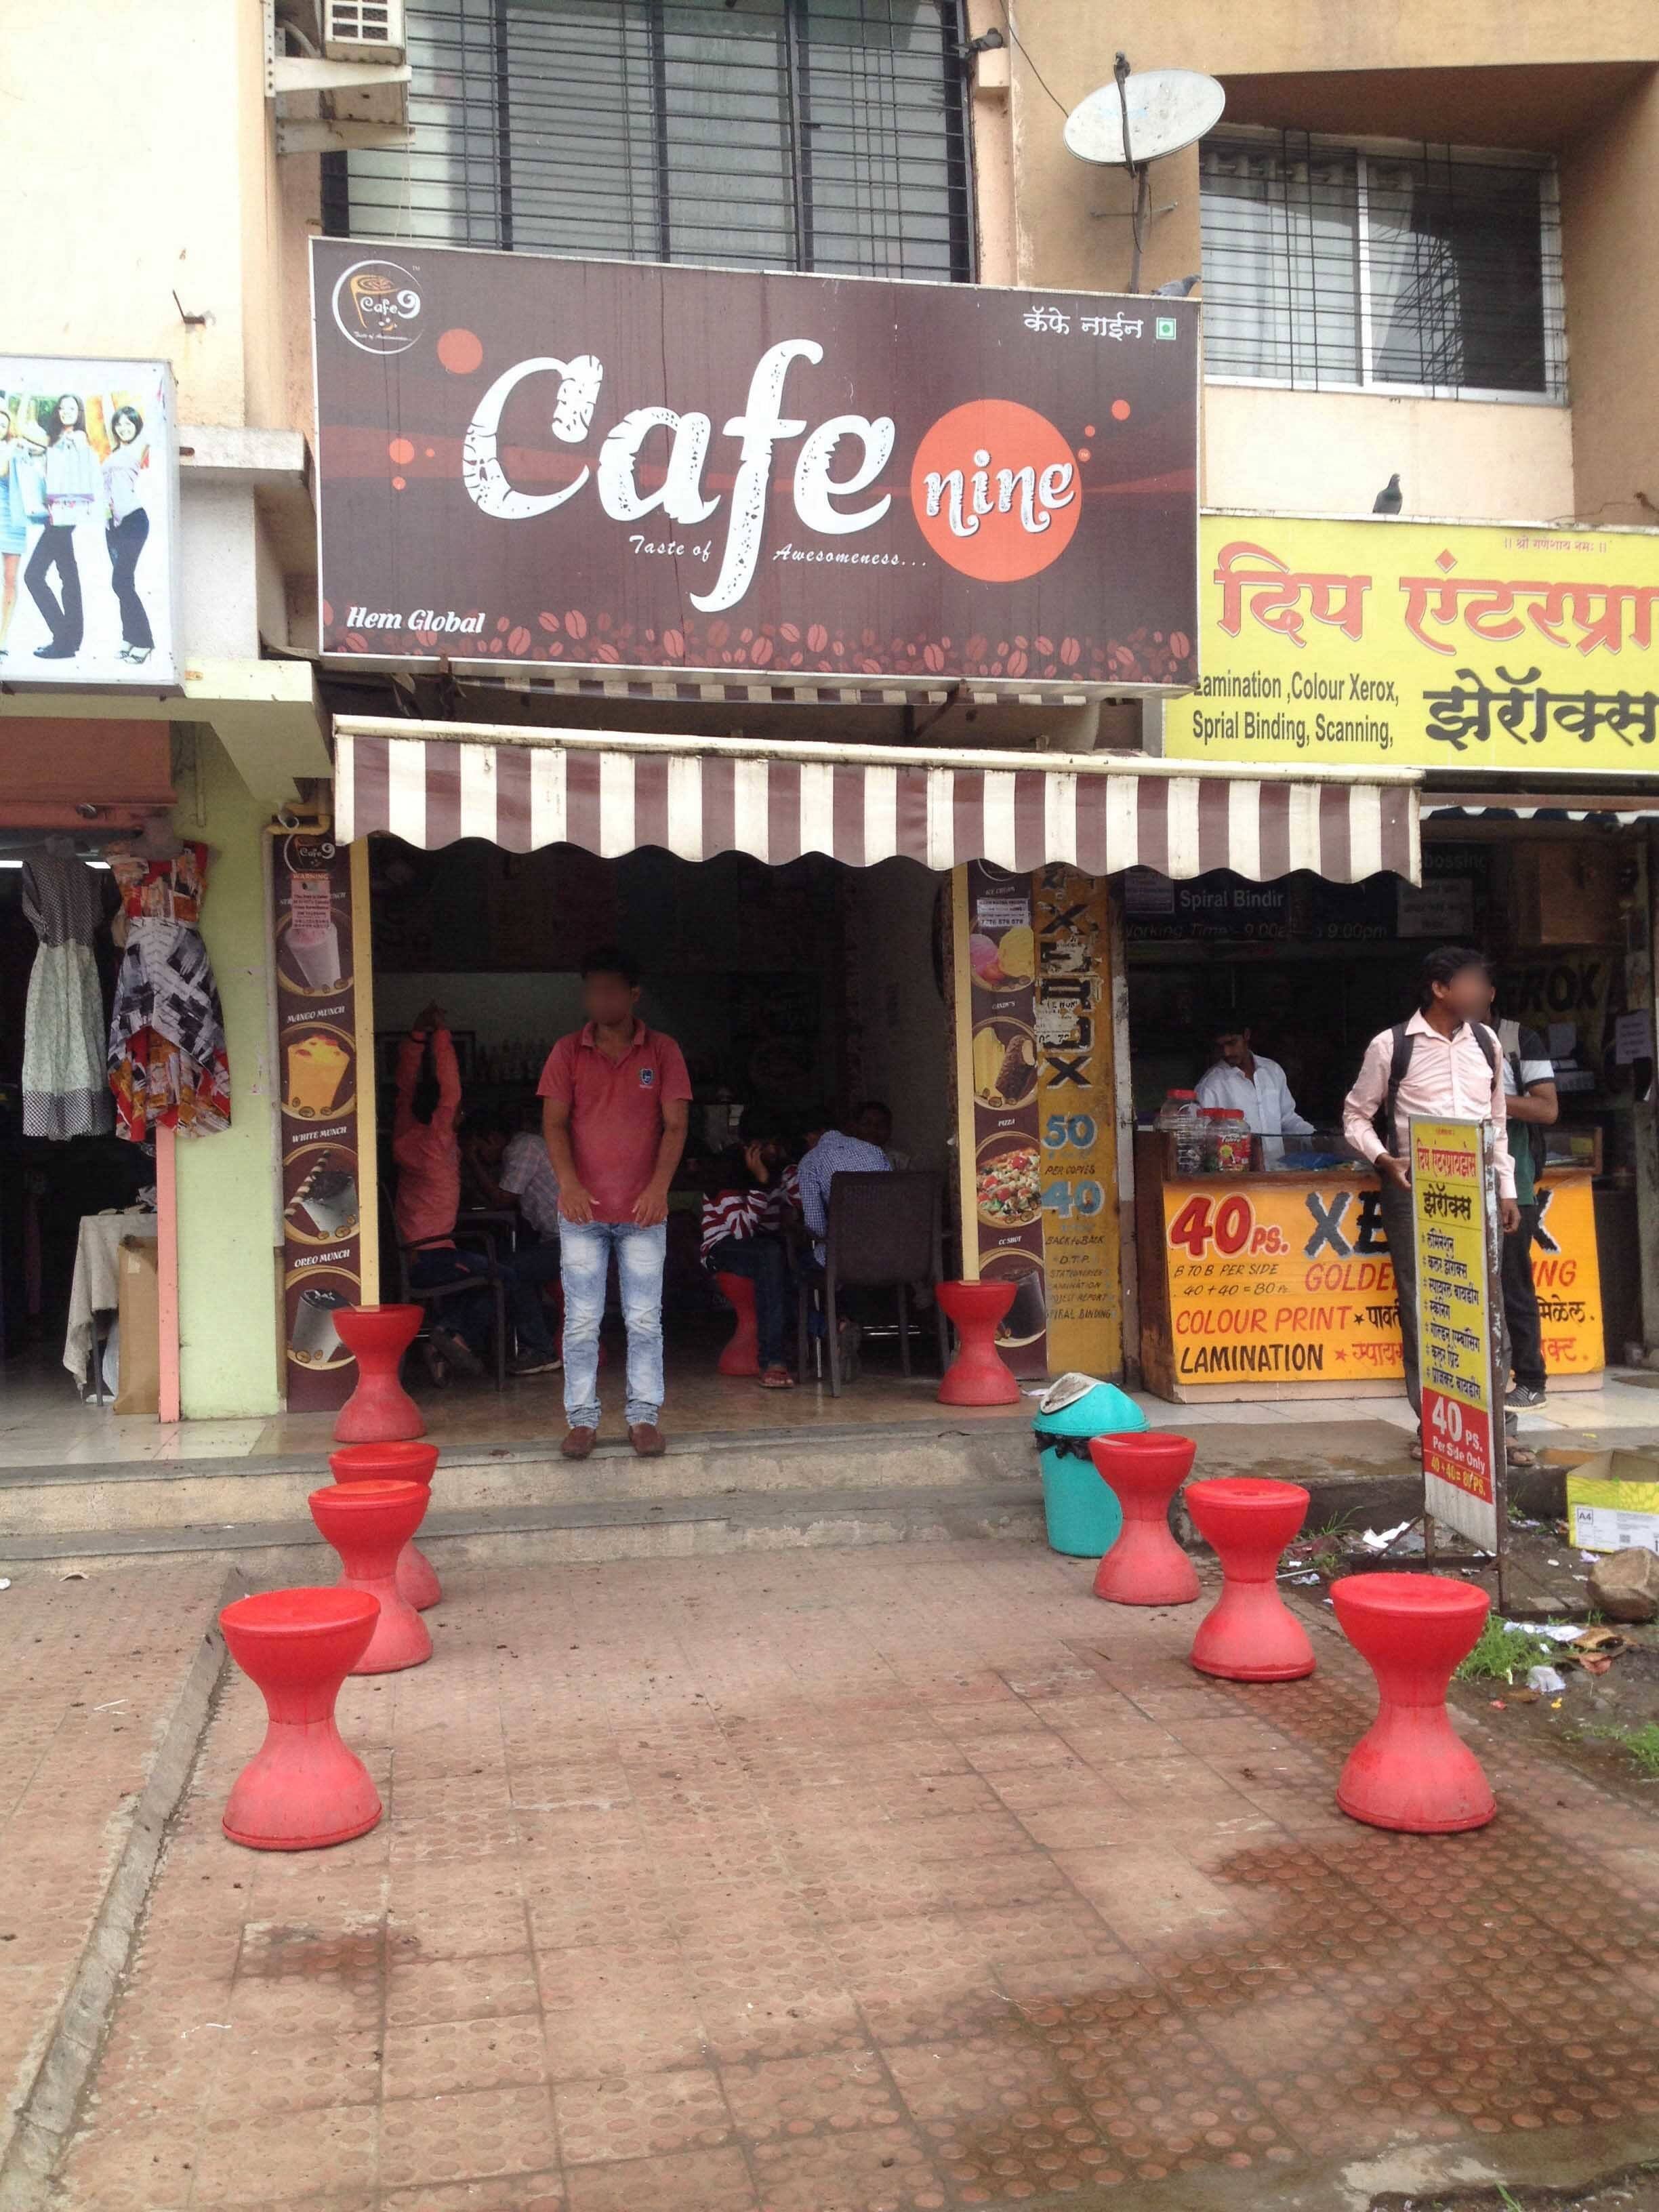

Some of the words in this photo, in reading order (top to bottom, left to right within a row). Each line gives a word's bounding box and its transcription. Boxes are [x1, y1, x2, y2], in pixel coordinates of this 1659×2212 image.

[360, 296, 398, 315] Cafe
[1023, 306, 1071, 335] कॅफे
[1080, 312, 1144, 341] नाईन
[463, 338, 895, 612] Cafe
[923, 448, 1076, 537] nine
[629, 535, 686, 557] Taste
[693, 540, 712, 562] of
[1214, 540, 1372, 649] दिप
[1399, 548, 1659, 657] एंटरप्रा
[346, 607, 402, 630] Hem
[408, 609, 486, 634] Global
[1349, 673, 1399, 707] Xerox,
[1422, 666, 1659, 751] झेरॉक्स
[1193, 710, 1239, 745] Sprial
[1244, 712, 1310, 748] Binding,
[1315, 713, 1393, 750] Scanning,
[1180, 889, 1228, 911] Spiral
[287, 1011, 316, 1023] MANGO
[316, 1006, 345, 1017] MUNCH
[293, 1130, 319, 1143] WHITE
[320, 1126, 347, 1138] MUNCH
[1041, 1113, 1098, 1150] 50
[1041, 1181, 1106, 1218] 40
[1422, 1183, 1472, 1221] झेरॉक्स
[1169, 1193, 1254, 1258] 40
[294, 1256, 319, 1268] OREO
[319, 1249, 350, 1263] MUNCH
[1187, 1265, 1202, 1277] TO
[1204, 1264, 1214, 1276] B
[1220, 1264, 1245, 1276] PER
[1248, 1263, 1279, 1275] SIDE
[1184, 1284, 1204, 1296] 40
[1218, 1284, 1240, 1296] 40
[1254, 1283, 1275, 1295] 80
[1176, 1308, 1268, 1335] COLOUR
[1275, 1306, 1353, 1333] PRINT
[1181, 1343, 1324, 1374] LAMINATION
[1432, 1395, 1462, 1442] 40
[1433, 1435, 1445, 1454] Per
[1446, 1442, 1465, 1462] Side
[1467, 1452, 1486, 1475] Only
[1579, 1512, 1591, 1521] A4
